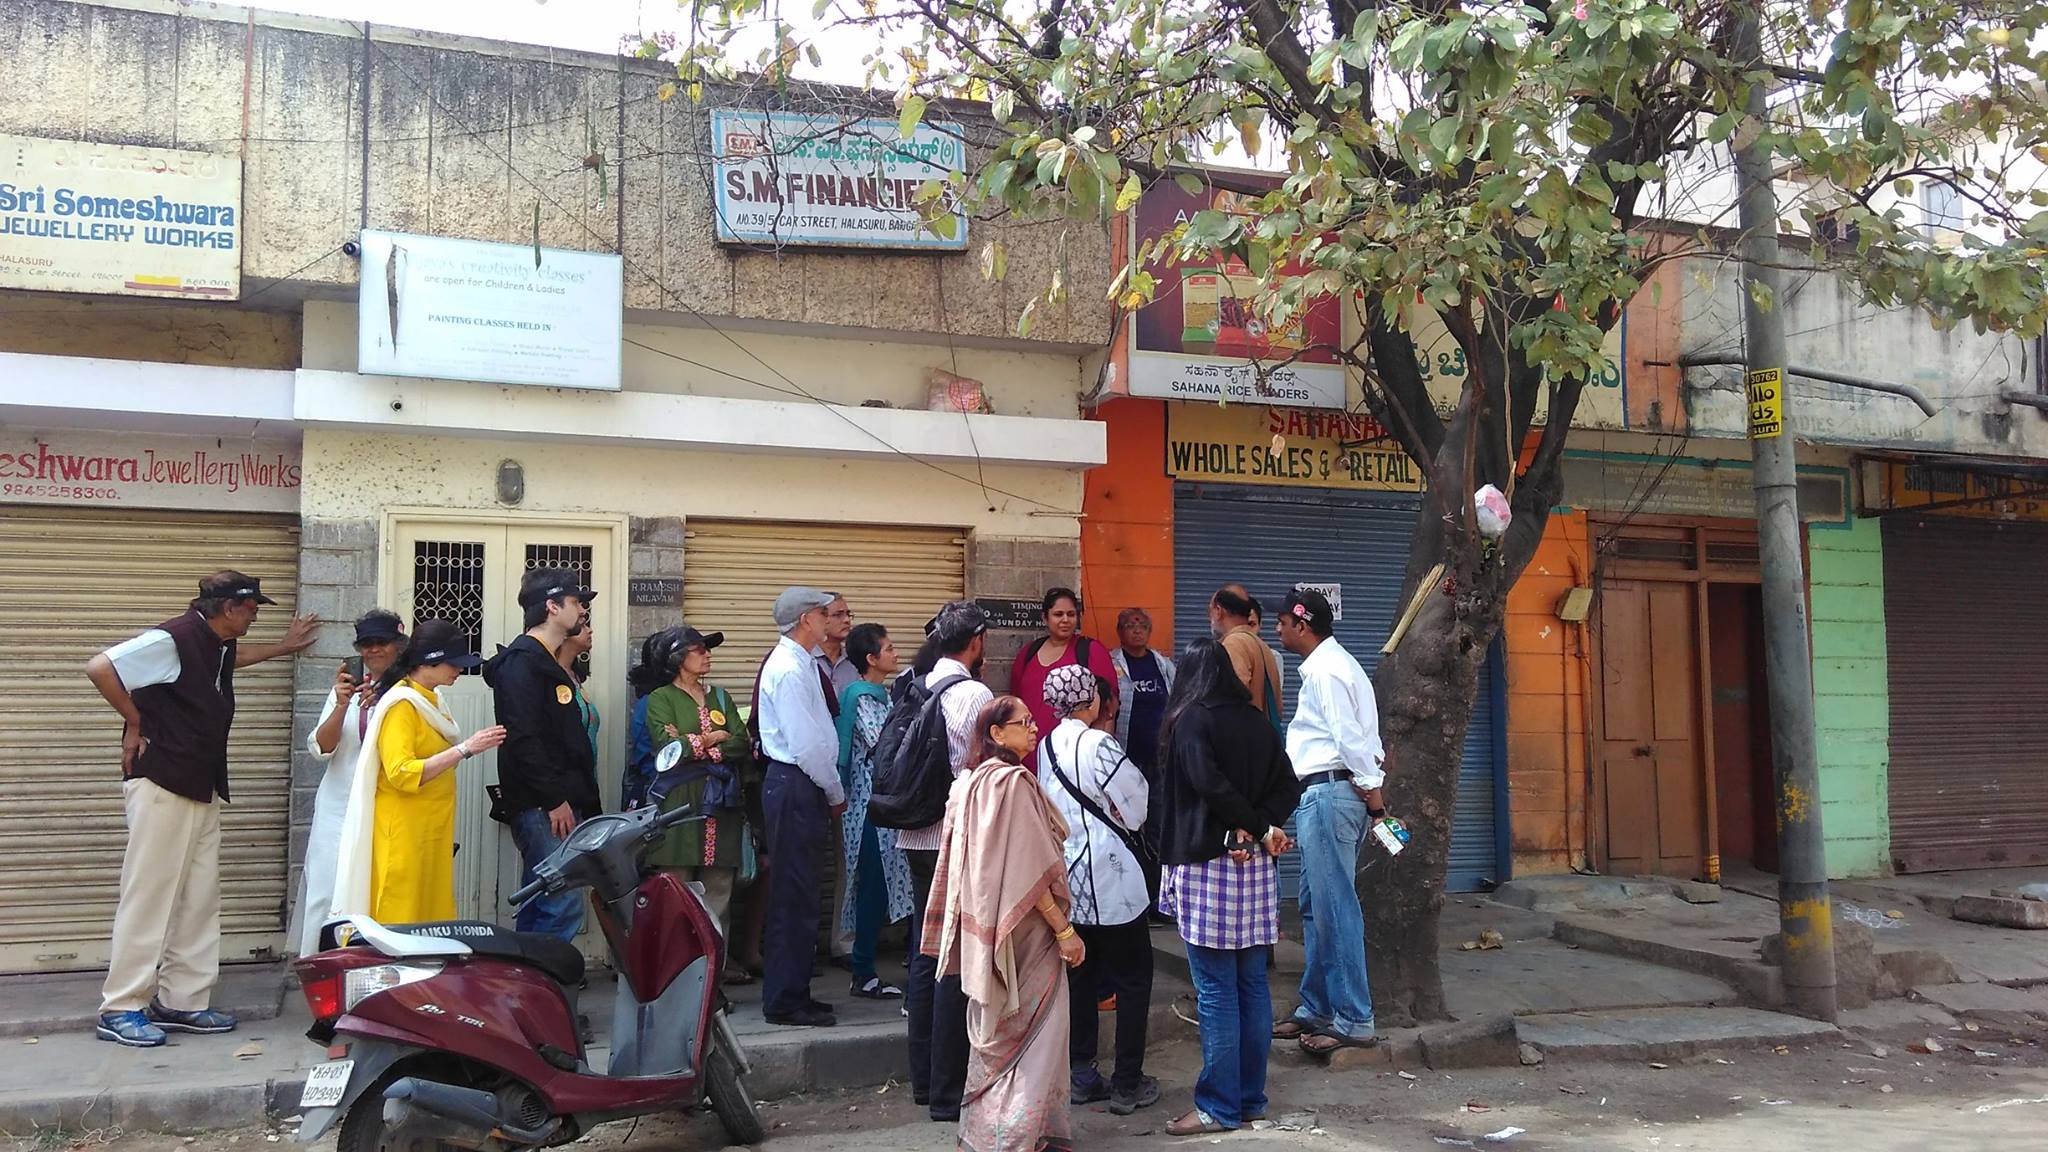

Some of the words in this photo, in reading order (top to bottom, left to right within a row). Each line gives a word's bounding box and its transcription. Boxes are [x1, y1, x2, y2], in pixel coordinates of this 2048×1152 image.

[0, 183, 46, 213] Sri
[53, 188, 235, 227] Someshwara
[779, 213, 798, 227] CAR
[800, 215, 838, 230] STREET,
[840, 219, 887, 232] HALASURU,
[0, 216, 135, 243] JEWELLERY
[144, 226, 234, 250] WORKS
[424, 275, 440, 283] are
[442, 276, 465, 287] open
[467, 277, 483, 287] for
[485, 279, 525, 291] Children
[526, 283, 534, 292] &
[536, 284, 566, 295] Ladies
[428, 313, 472, 325] PAINTING
[473, 317, 515, 329] CLASSES
[517, 321, 541, 331] HELD
[542, 323, 552, 332] IN
[1171, 380, 1222, 395] SAHANA
[142, 450, 239, 493] Jewellery
[240, 453, 301, 489] Works
[1171, 440, 1246, 475] WHOLE
[1251, 445, 1313, 479] SALES
[1319, 450, 1330, 480] &
[1350, 450, 1416, 484] RETAIL
[631, 582, 639, 592] R
[640, 582, 680, 593] RAMESH
[636, 594, 674, 603] NILAYAM
[997, 618, 1033, 628] SUNDAY
[1014, 611, 1029, 619] TO
[453, 926, 494, 936] HONDA
